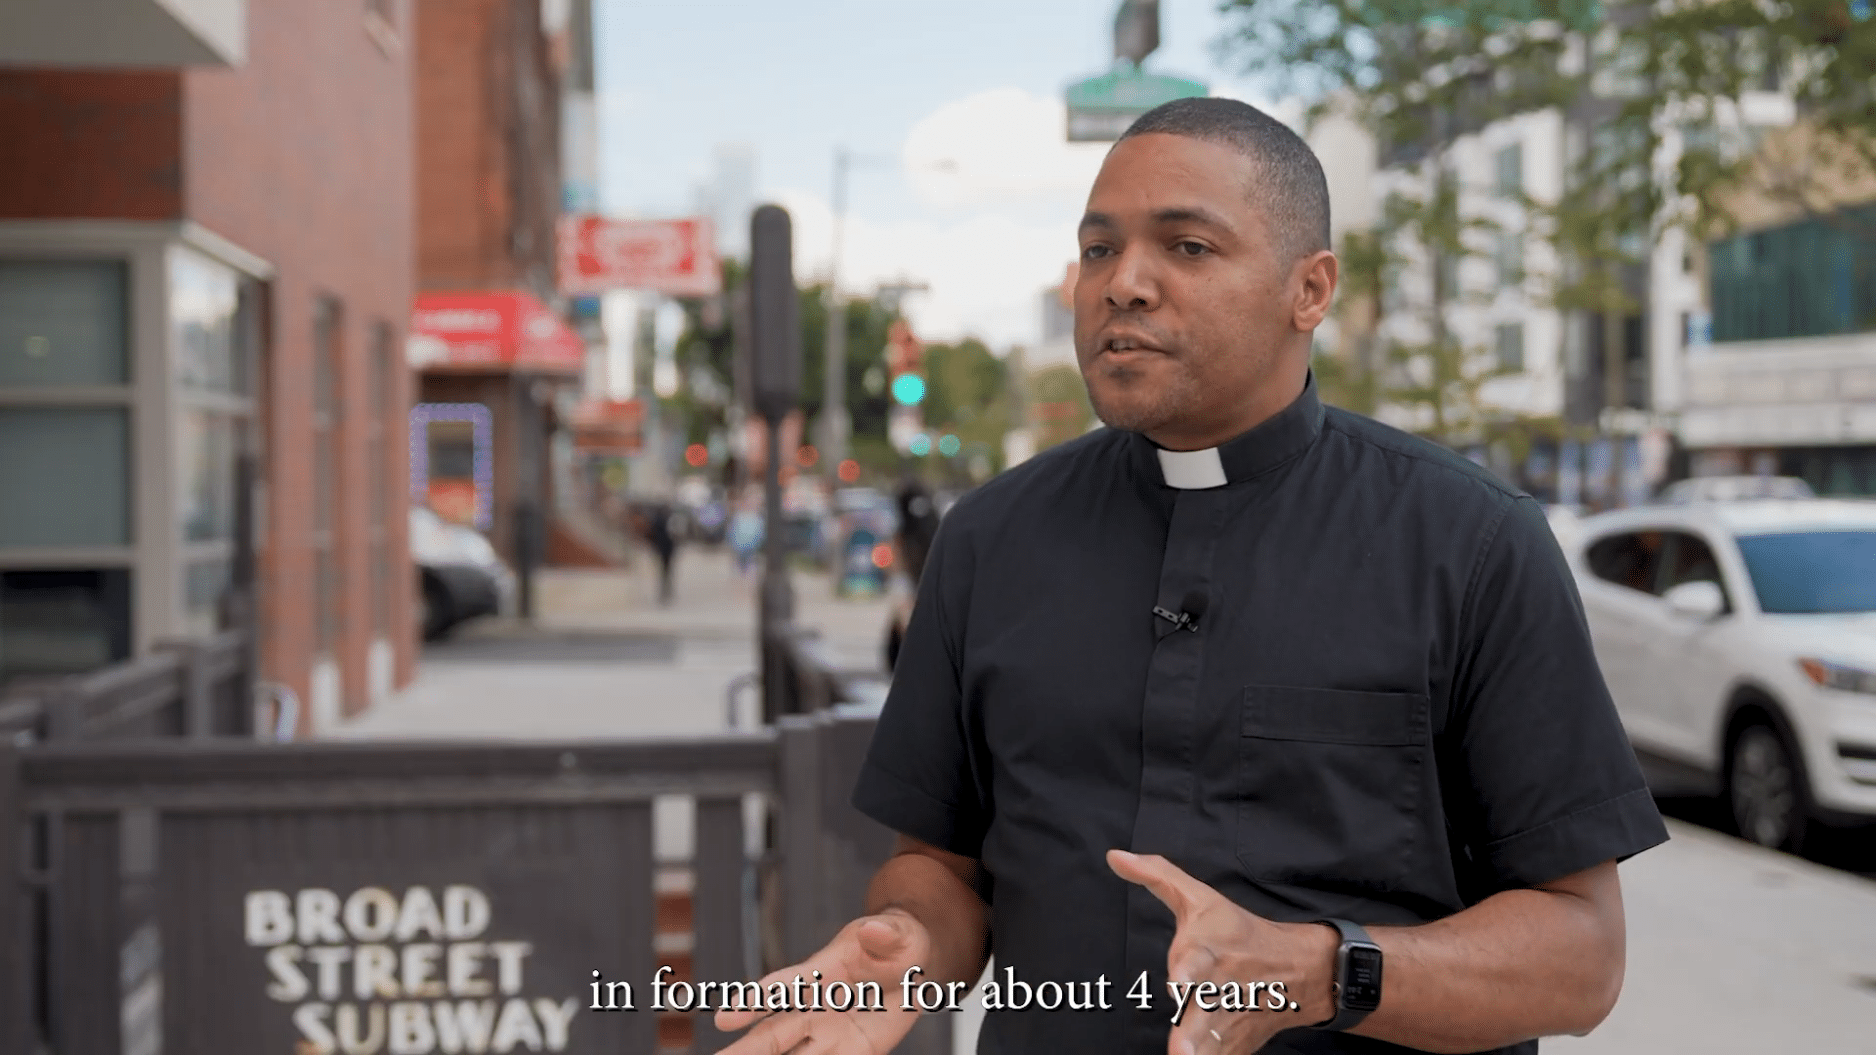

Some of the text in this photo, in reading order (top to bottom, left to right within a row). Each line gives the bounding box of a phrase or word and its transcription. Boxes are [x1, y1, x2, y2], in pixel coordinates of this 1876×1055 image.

[244, 885, 491, 945] BROAD
[266, 941, 532, 1001] STREET
[292, 997, 578, 1054] SUBWAY
